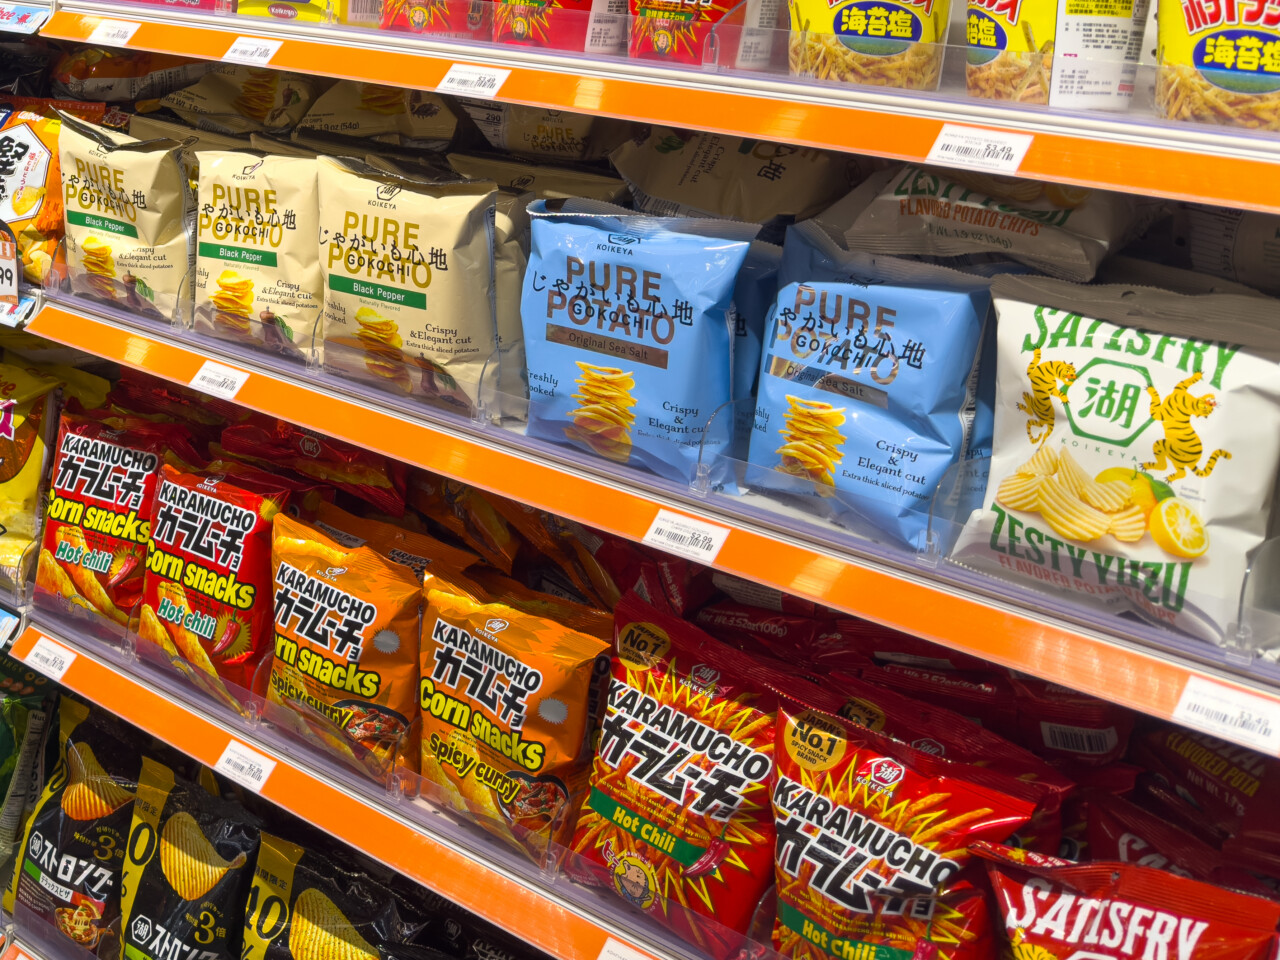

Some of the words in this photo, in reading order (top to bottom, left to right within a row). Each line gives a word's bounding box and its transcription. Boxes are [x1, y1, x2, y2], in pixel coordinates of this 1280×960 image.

[839, 6, 913, 36] 海苔塩
[485, 113, 501, 122] 290
[986, 144, 1012, 154] $3.49
[212, 183, 277, 215] PURE
[368, 199, 397, 211] KOIKEYA
[85, 216, 104, 228] Black
[105, 219, 125, 233] Pepper
[219, 246, 240, 260] Black
[242, 249, 263, 264] Pepper
[596, 243, 634, 256] KOIKEYA
[347, 253, 411, 277] GOKOCHI
[353, 281, 373, 294] Black
[375, 285, 406, 303] Pepper
[359, 298, 379, 310] Naturally
[380, 302, 401, 312] Flavored
[531, 269, 694, 327] じゃがいも心地
[425, 323, 458, 339] Crispy
[572, 300, 650, 332] GOKOCHI
[406, 340, 421, 349] Extra
[422, 342, 436, 350] thick
[437, 344, 451, 352] sliced
[452, 345, 479, 354] potatoes
[568, 331, 607, 352] Original
[608, 340, 625, 354] Sea
[627, 345, 649, 361] Salt
[1021, 305, 1244, 391] SATISFRY
[786, 363, 820, 384] Original
[820, 374, 838, 390] Sea
[840, 380, 865, 398] Salt
[662, 400, 699, 418] Crispy
[1080, 377, 1140, 429] 湖
[674, 415, 684, 425] &
[857, 456, 902, 478] Elegant
[904, 471, 927, 486] cut
[888, 456, 899, 465] &
[158, 480, 257, 533] KARAMUCHO
[690, 531, 713, 543] $2.99
[55, 540, 81, 564] Hot
[81, 550, 111, 574] chili
[990, 503, 1089, 577] ZESTY
[1090, 552, 1193, 613] YUZU
[276, 561, 377, 626] KARAMUCHO
[307, 642, 381, 700] snacks
[420, 675, 471, 732] Corn
[470, 707, 546, 771] snacks
[790, 721, 838, 756] No.1
[790, 739, 811, 754] SPICY
[808, 746, 829, 763] SNACK
[428, 731, 476, 775] Spicy
[475, 759, 522, 803] curry
[598, 713, 752, 824] カラムーチョ
[796, 751, 818, 765] BRAND
[611, 806, 639, 832] Hot
[640, 819, 677, 854] Chili
[216, 927, 227, 938] 倍
